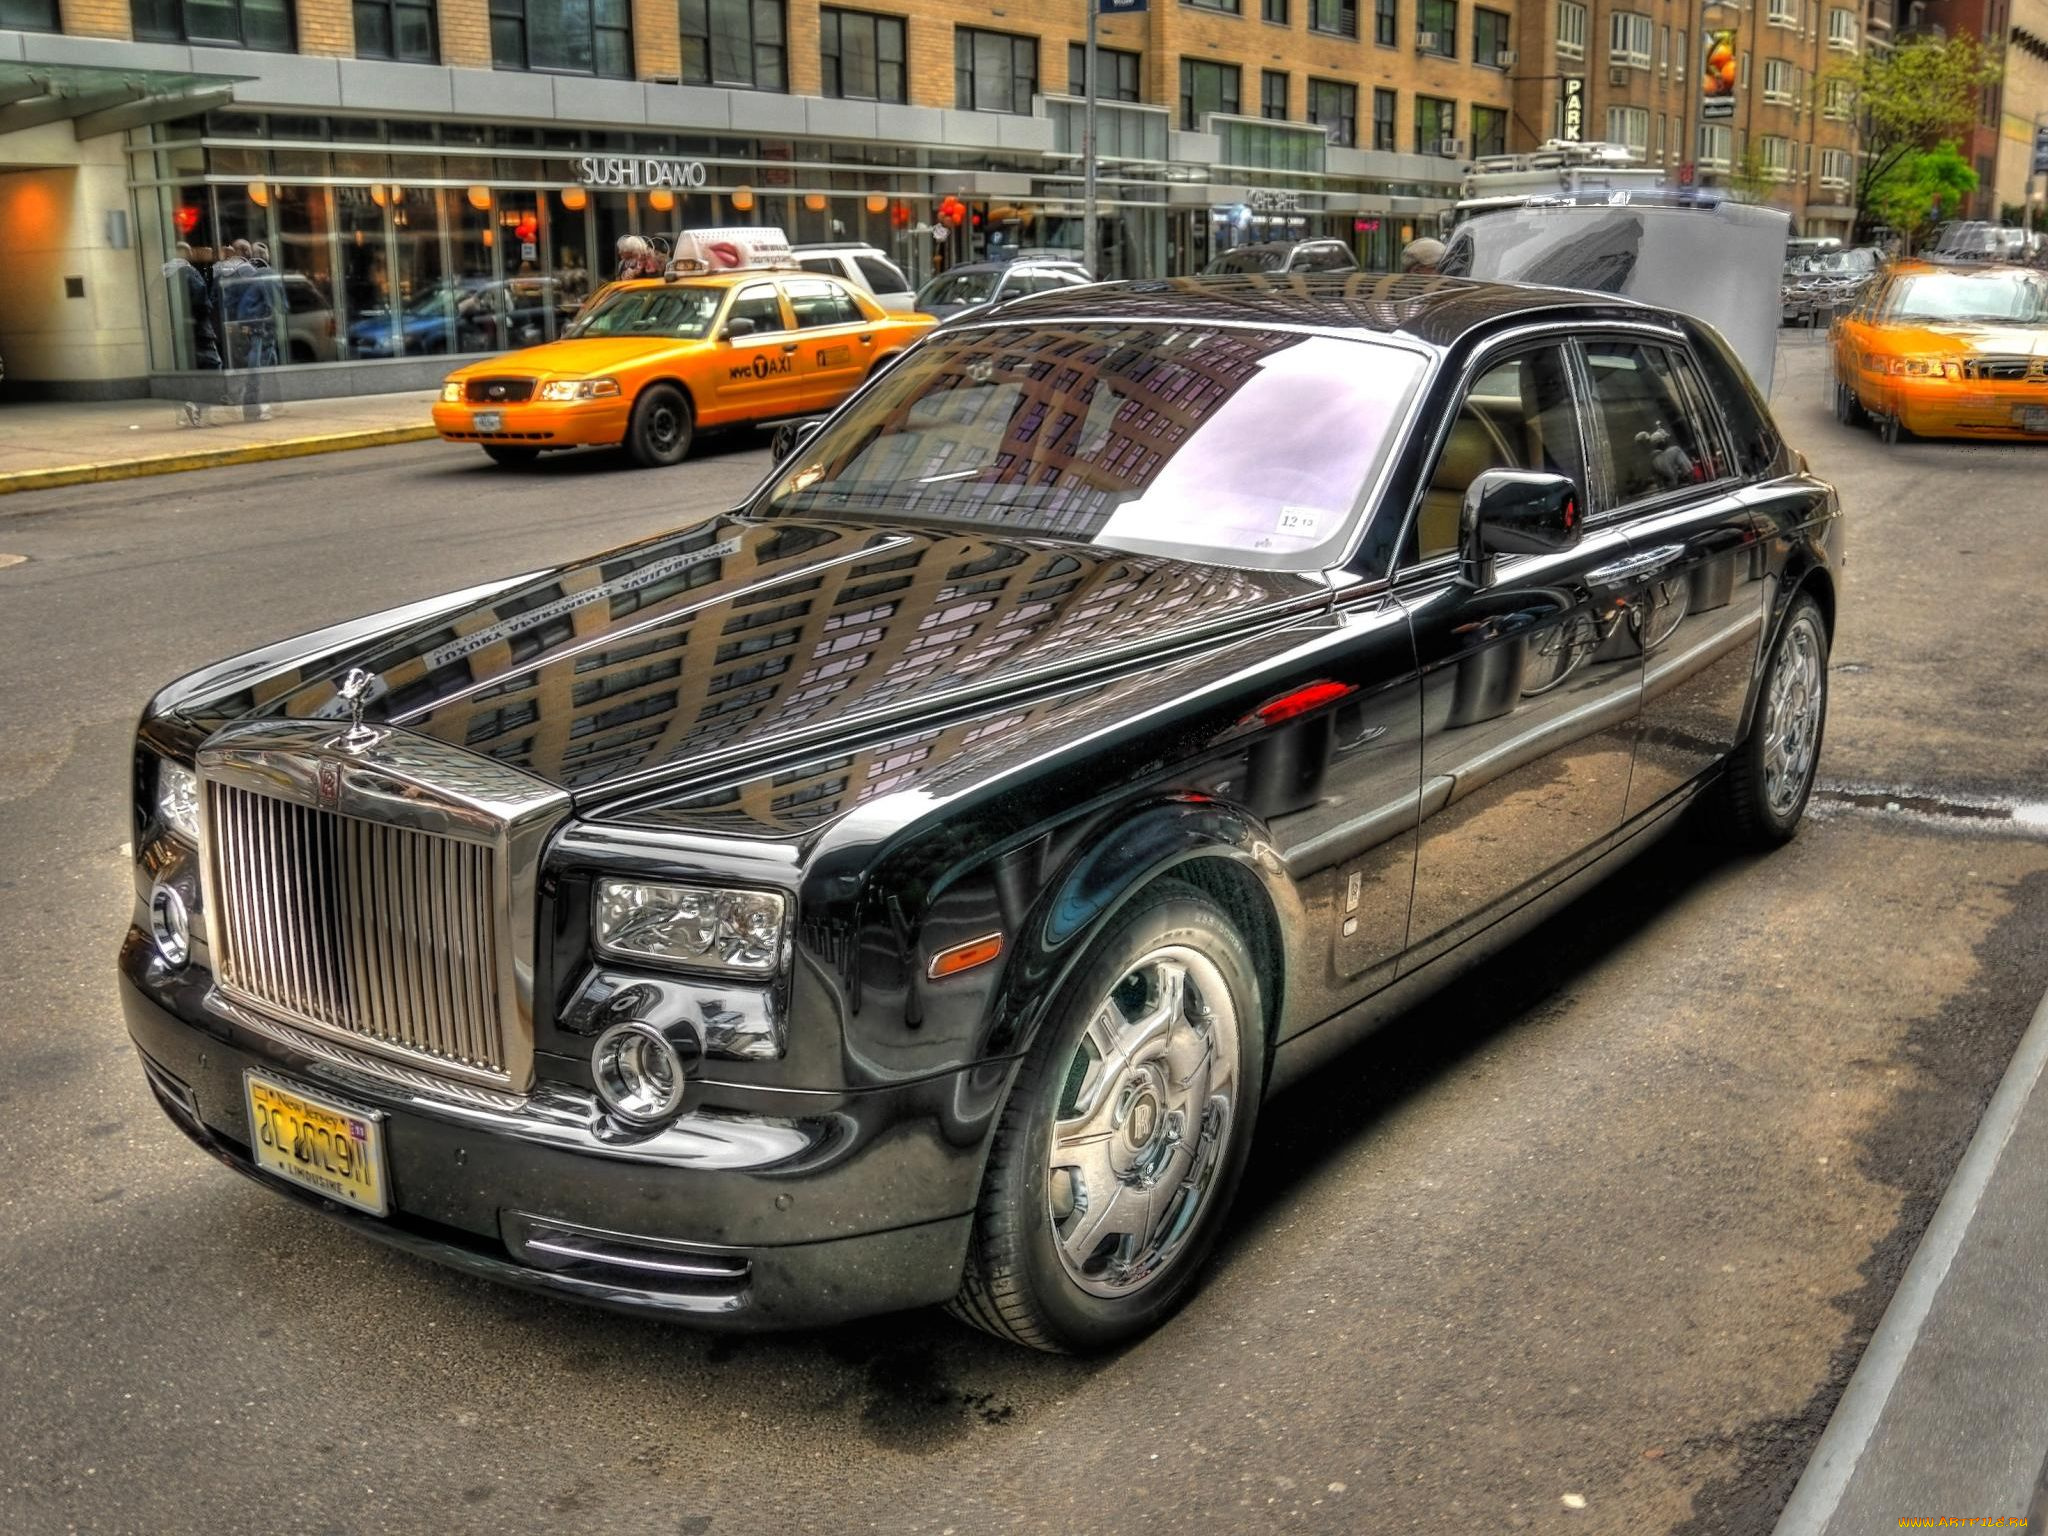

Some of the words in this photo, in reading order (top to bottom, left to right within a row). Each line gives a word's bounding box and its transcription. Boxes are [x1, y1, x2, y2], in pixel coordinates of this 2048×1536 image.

[1565, 79, 1582, 141] PARK
[581, 157, 639, 185] SUSHI
[645, 160, 706, 187] DAMO
[729, 365, 752, 380] NYC
[752, 354, 791, 379] TAXI
[1281, 515, 1298, 528] 12
[276, 1091, 303, 1113] New
[303, 1101, 338, 1131] Jersey
[288, 1163, 344, 1195] LIMOUSINE
